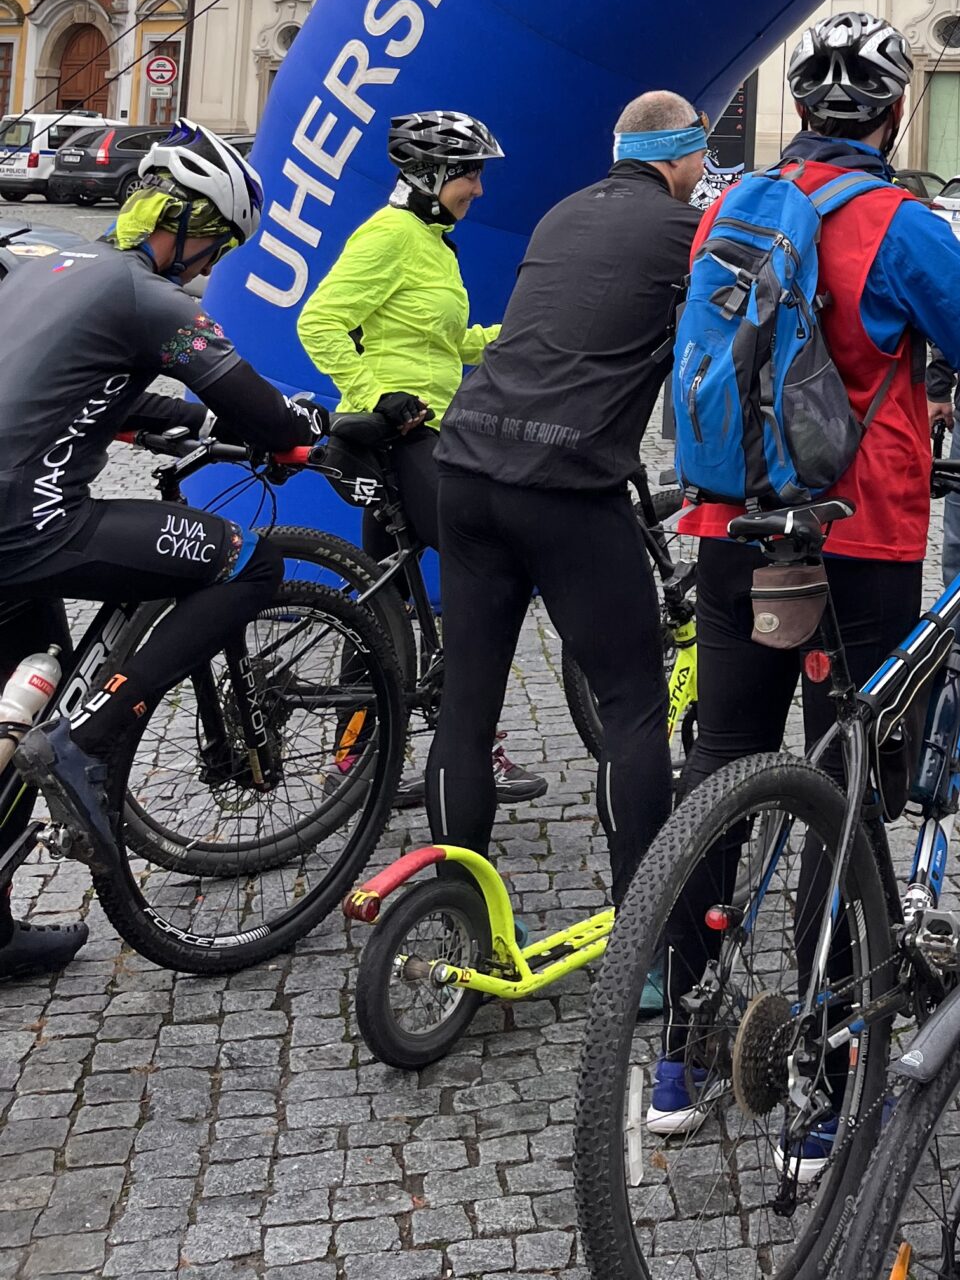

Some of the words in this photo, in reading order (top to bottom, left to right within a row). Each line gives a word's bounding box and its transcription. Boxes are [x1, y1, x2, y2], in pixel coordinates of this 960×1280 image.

[501, 417, 523, 440] ARE
[523, 421, 581, 449] BEAUTIFUL
[160, 514, 207, 541] JUVA
[667, 666, 691, 724] STKA
[143, 907, 215, 948] FORCE
